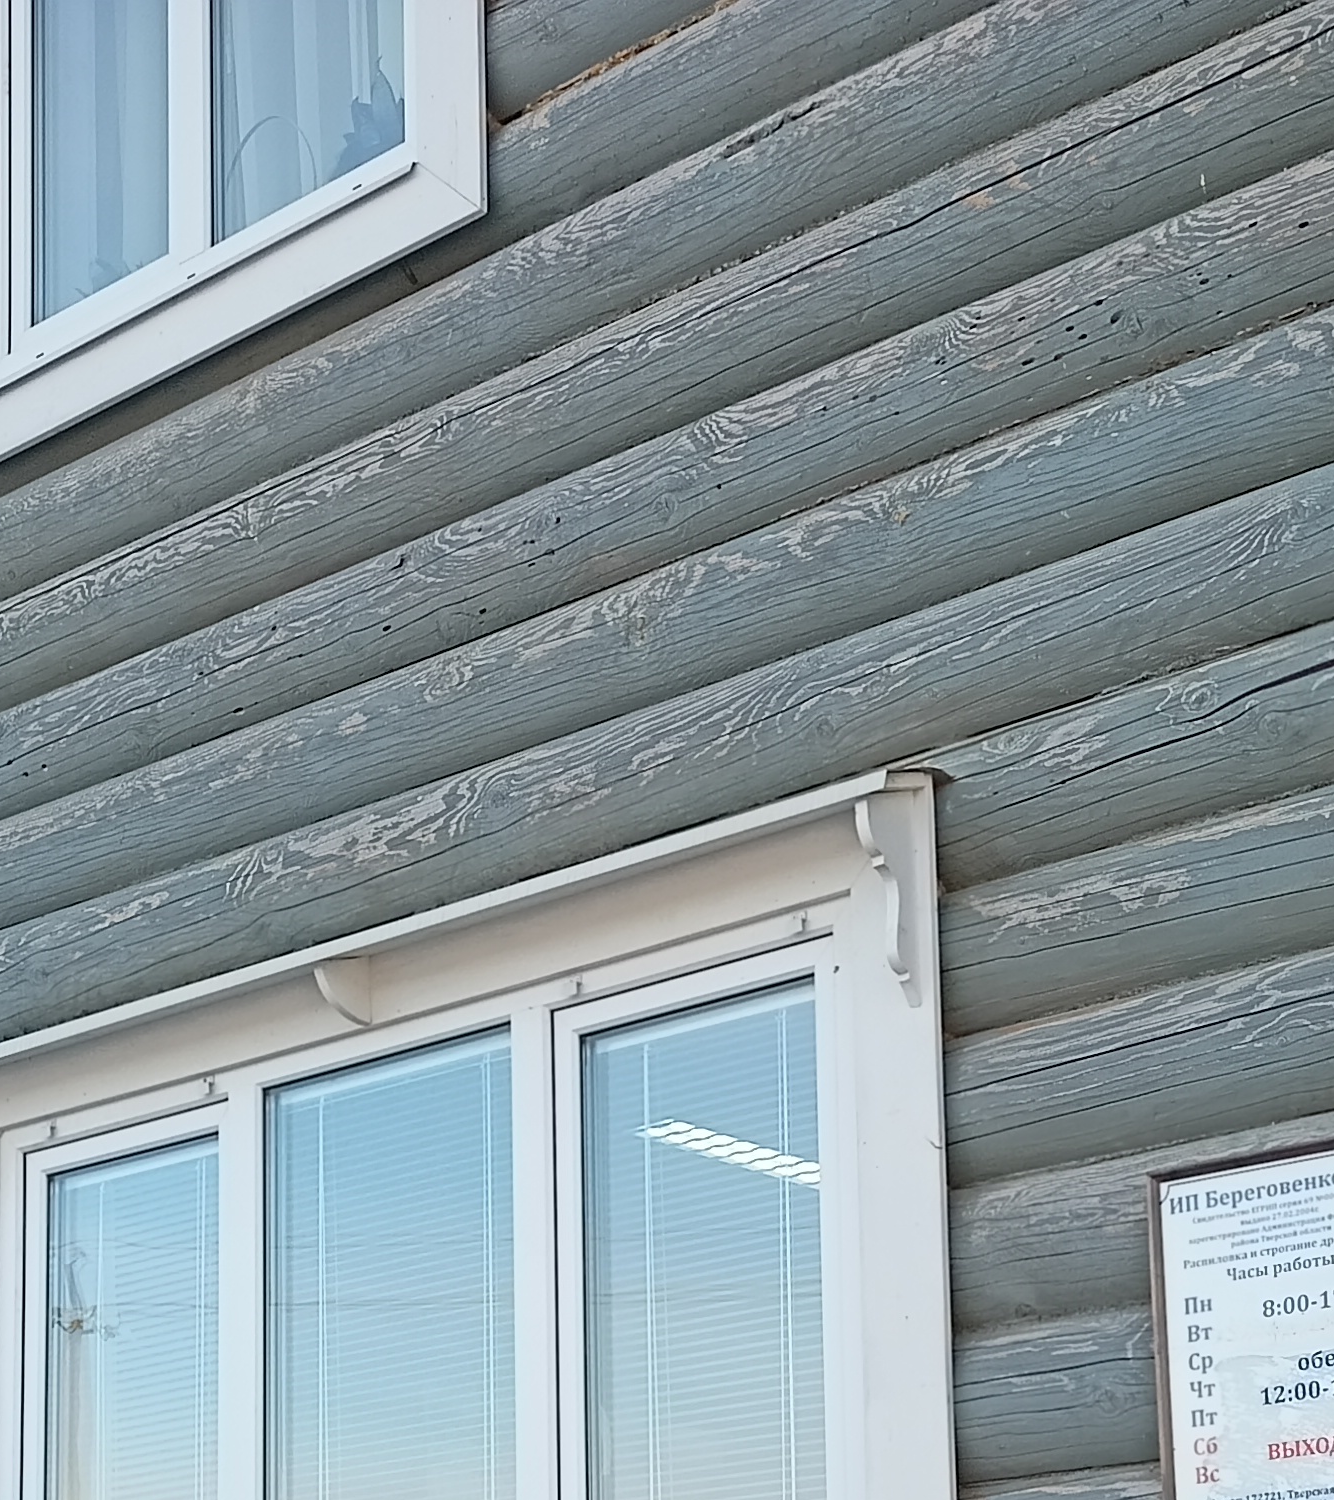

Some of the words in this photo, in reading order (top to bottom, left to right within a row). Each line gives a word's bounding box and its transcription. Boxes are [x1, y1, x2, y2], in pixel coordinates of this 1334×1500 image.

[1169, 1193, 1199, 1215] ИП
[1183, 1251, 1248, 1270] Распиловка
[1250, 1250, 1258, 1258] и
[1259, 1239, 1318, 1257] строгание
[1226, 1264, 1269, 1282] Часы
[1183, 1296, 1213, 1316] Пн
[1187, 1325, 1213, 1343] Вт
[1188, 1352, 1214, 1375] Ср
[1189, 1380, 1216, 1400] Чт
[1191, 1409, 1218, 1428] Пт
[1193, 1436, 1218, 1456] Сб
[1195, 1466, 1221, 1485] Вс
